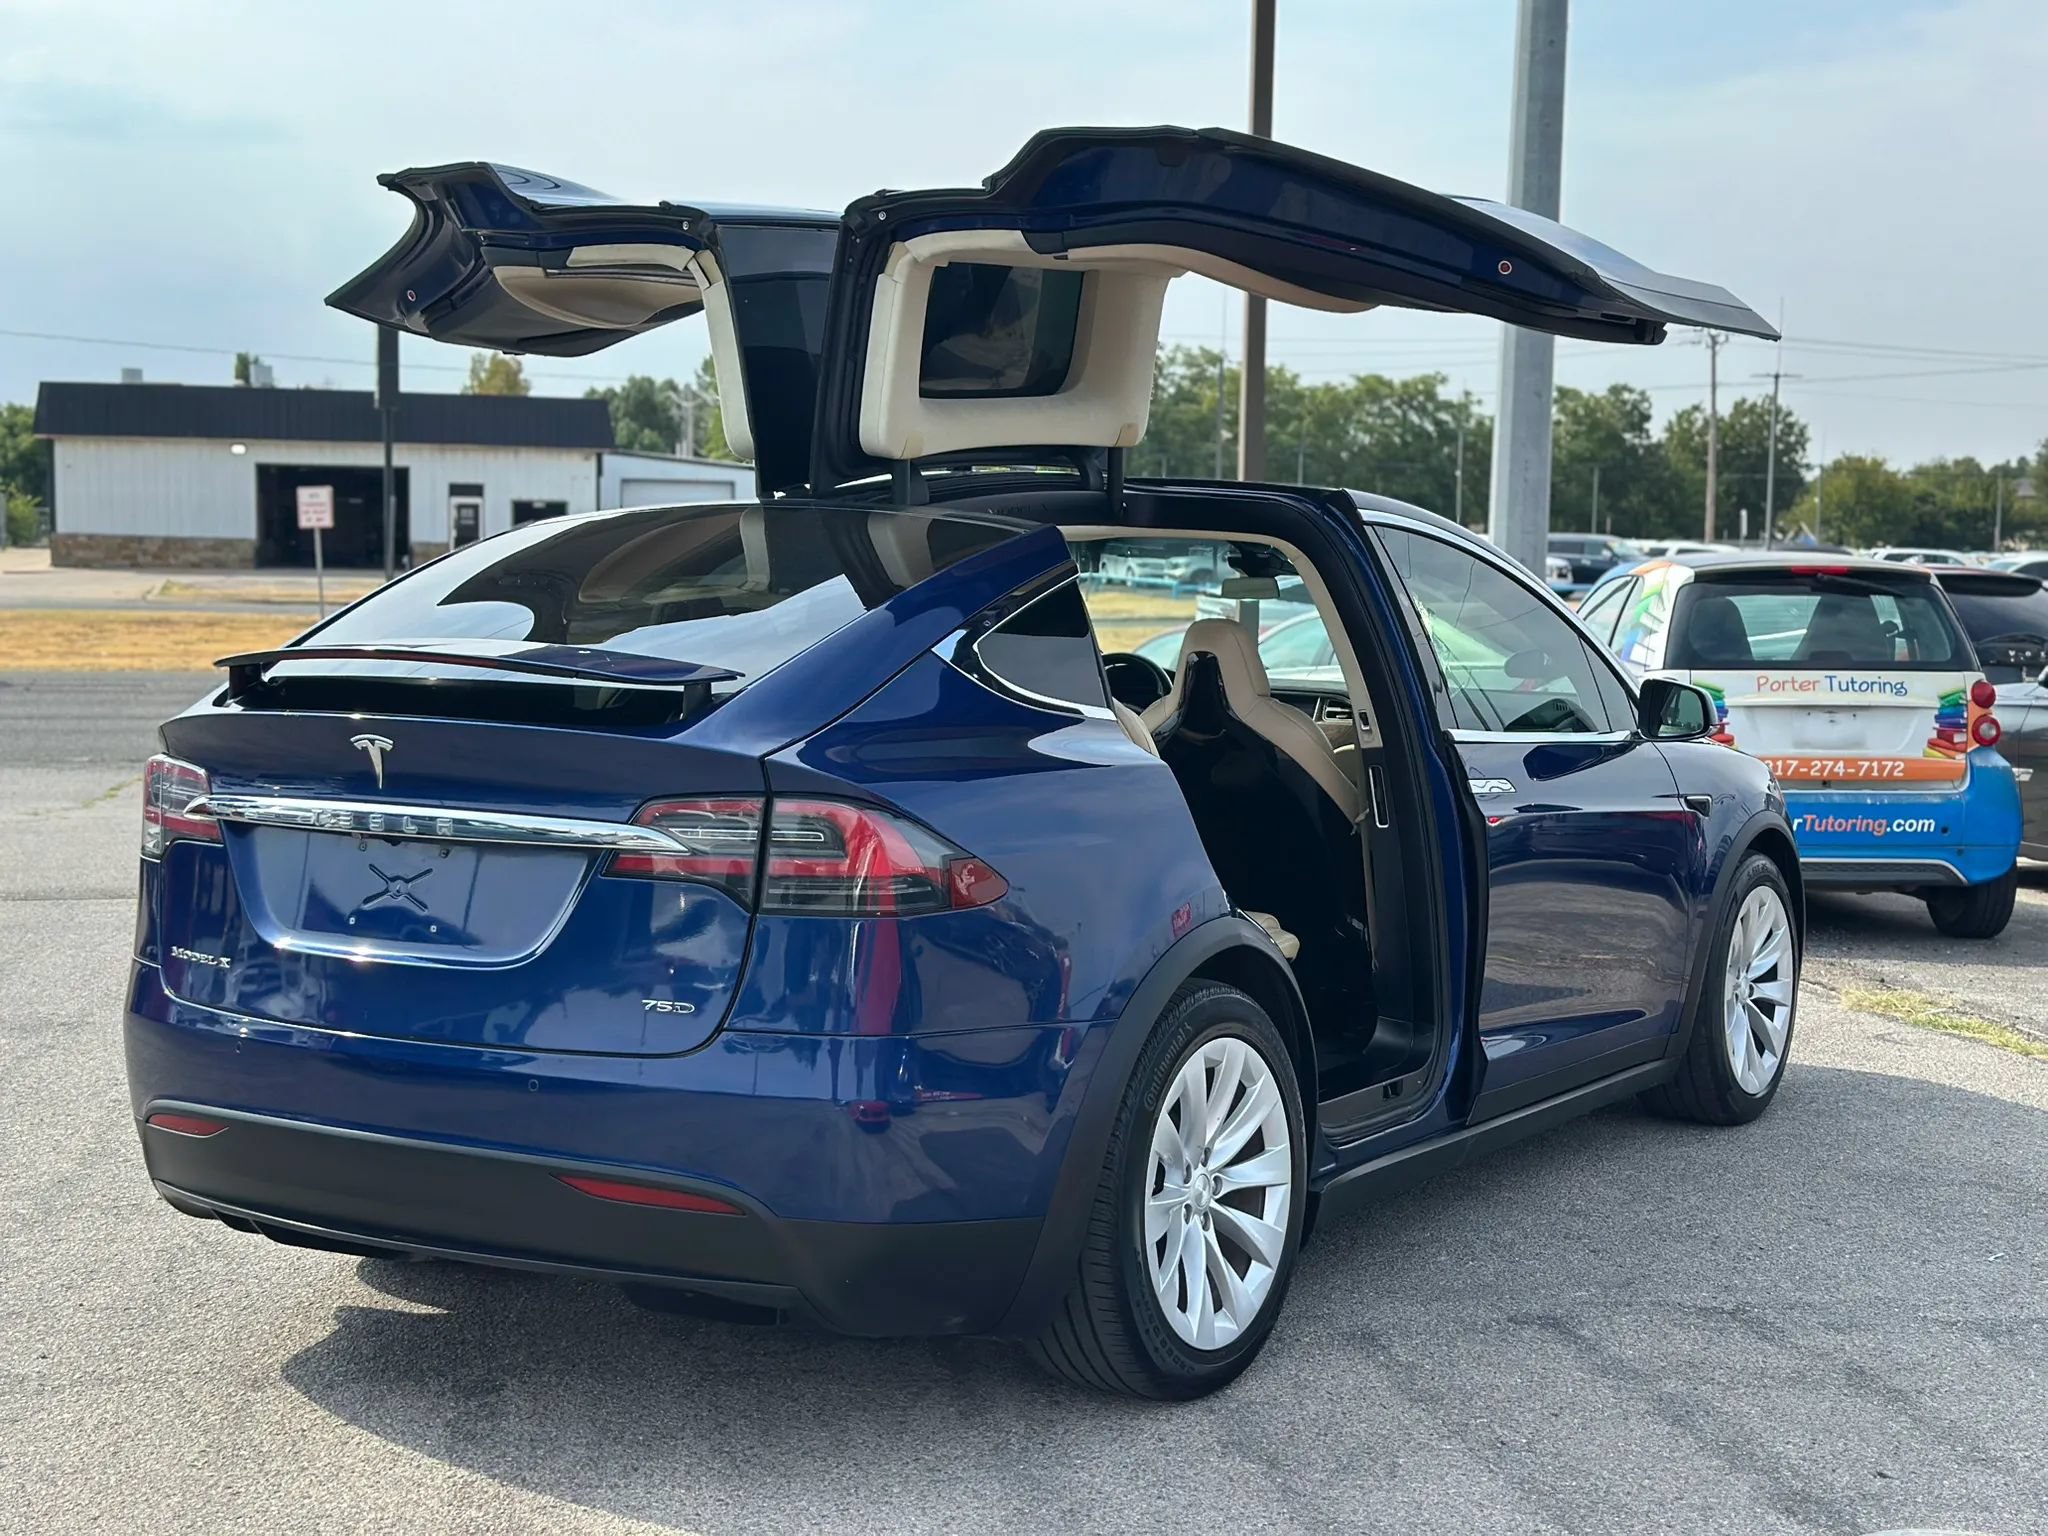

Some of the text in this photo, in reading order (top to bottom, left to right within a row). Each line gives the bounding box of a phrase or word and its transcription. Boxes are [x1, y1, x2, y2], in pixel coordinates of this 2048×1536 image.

[1756, 675, 1908, 697] Porter Tutoring
[1793, 814, 1936, 837] rTutoring.com
[171, 946, 231, 968] MODEL X
[641, 999, 695, 1014] 75D
